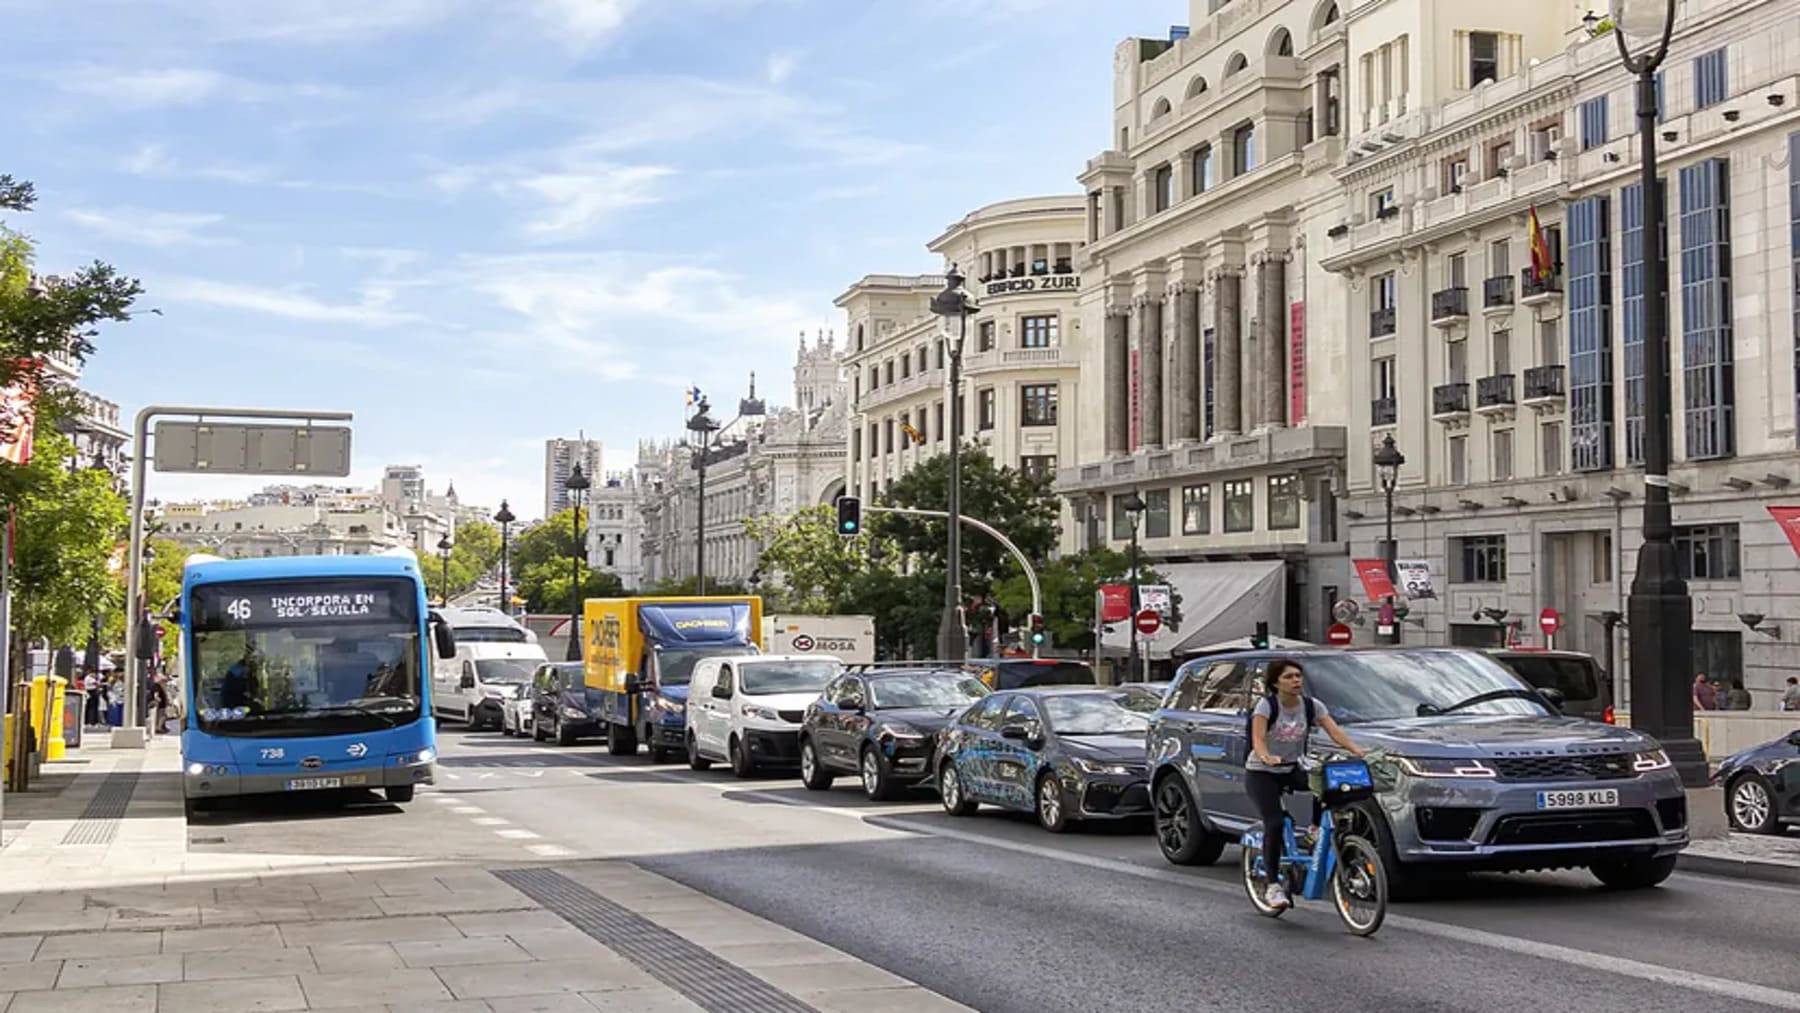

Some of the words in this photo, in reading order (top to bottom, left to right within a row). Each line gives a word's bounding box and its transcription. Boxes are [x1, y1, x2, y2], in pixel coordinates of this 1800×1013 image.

[227, 599, 251, 619] 46
[271, 595, 351, 608] INCORPORA
[355, 594, 374, 604] EN
[1547, 793, 1585, 807] 5998
[1588, 791, 1616, 805] KLB
